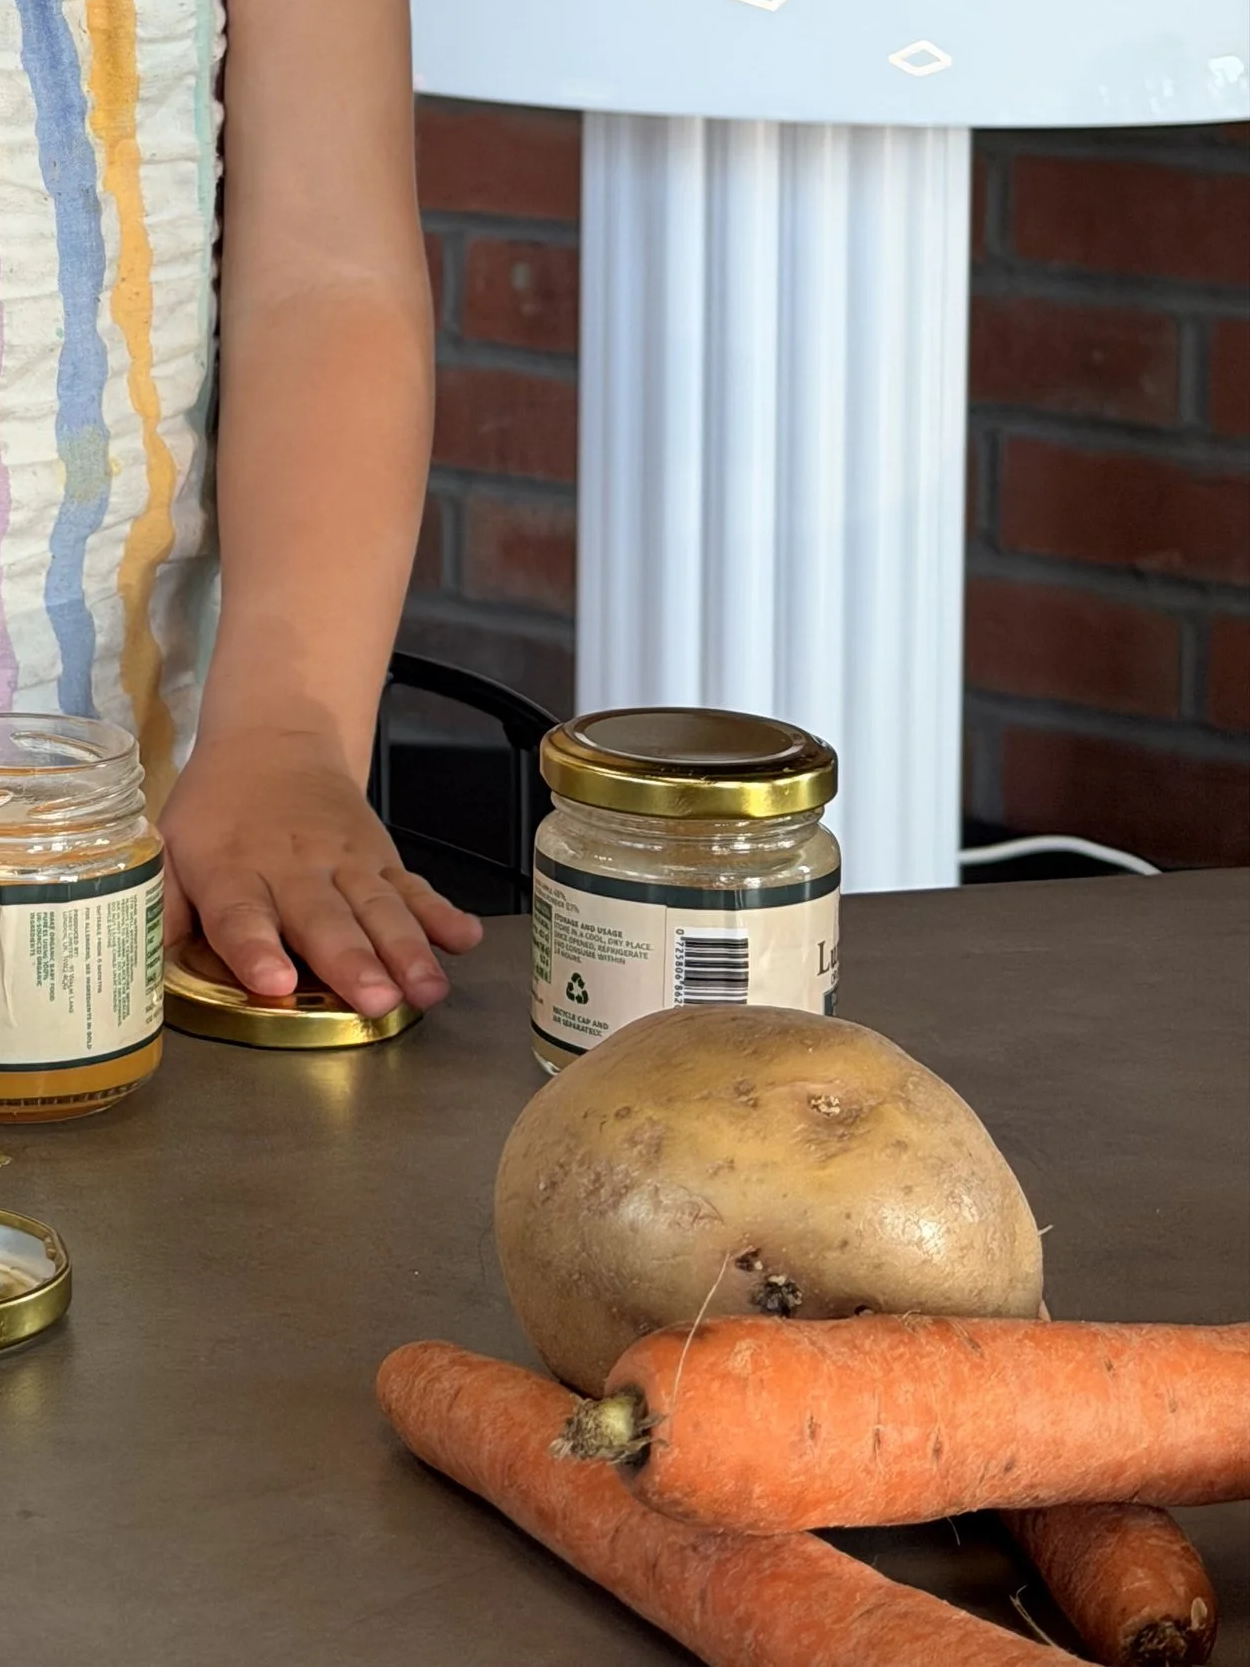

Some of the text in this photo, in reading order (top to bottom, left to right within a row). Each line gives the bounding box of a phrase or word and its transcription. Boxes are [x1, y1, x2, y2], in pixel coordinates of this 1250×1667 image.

[580, 923, 595, 932] AND
[597, 926, 623, 938] USAGE
[608, 938, 624, 947] DRY
[598, 944, 649, 960] REFRIGERATE
[674, 941, 684, 980] 725806
[577, 1015, 591, 1024] CAP
[592, 1020, 609, 1030] AND
